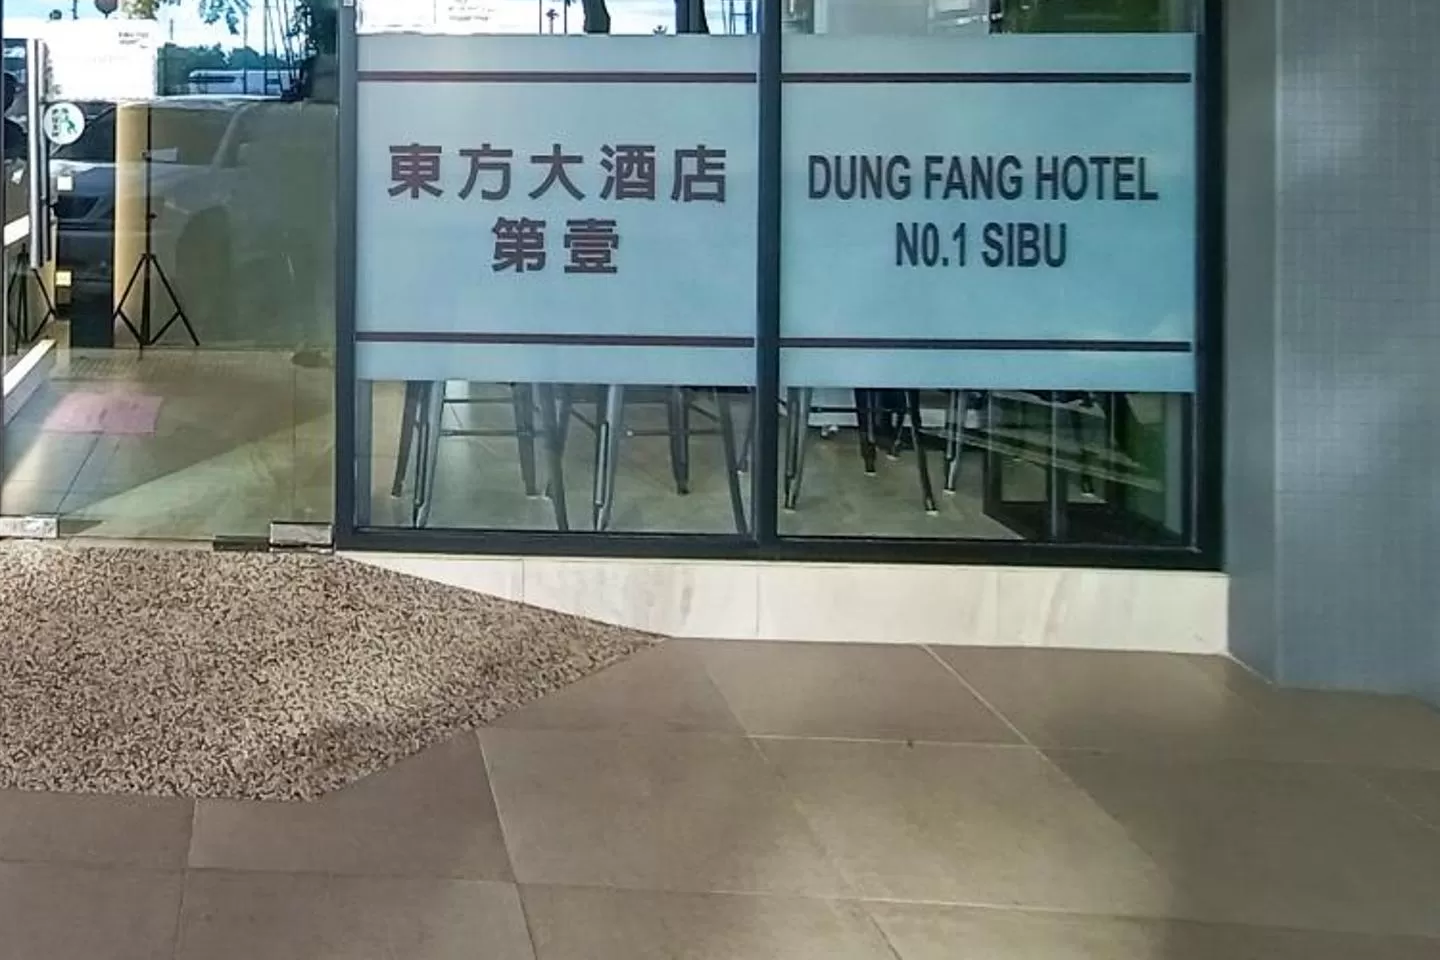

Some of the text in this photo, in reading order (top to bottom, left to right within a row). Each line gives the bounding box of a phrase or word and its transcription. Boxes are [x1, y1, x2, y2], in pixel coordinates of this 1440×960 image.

[385, 143, 729, 204] 東方大酒店
[808, 155, 1160, 201] DUNG FANG HOTEL
[490, 216, 621, 275] 第壹
[981, 222, 1068, 268] SIBU
